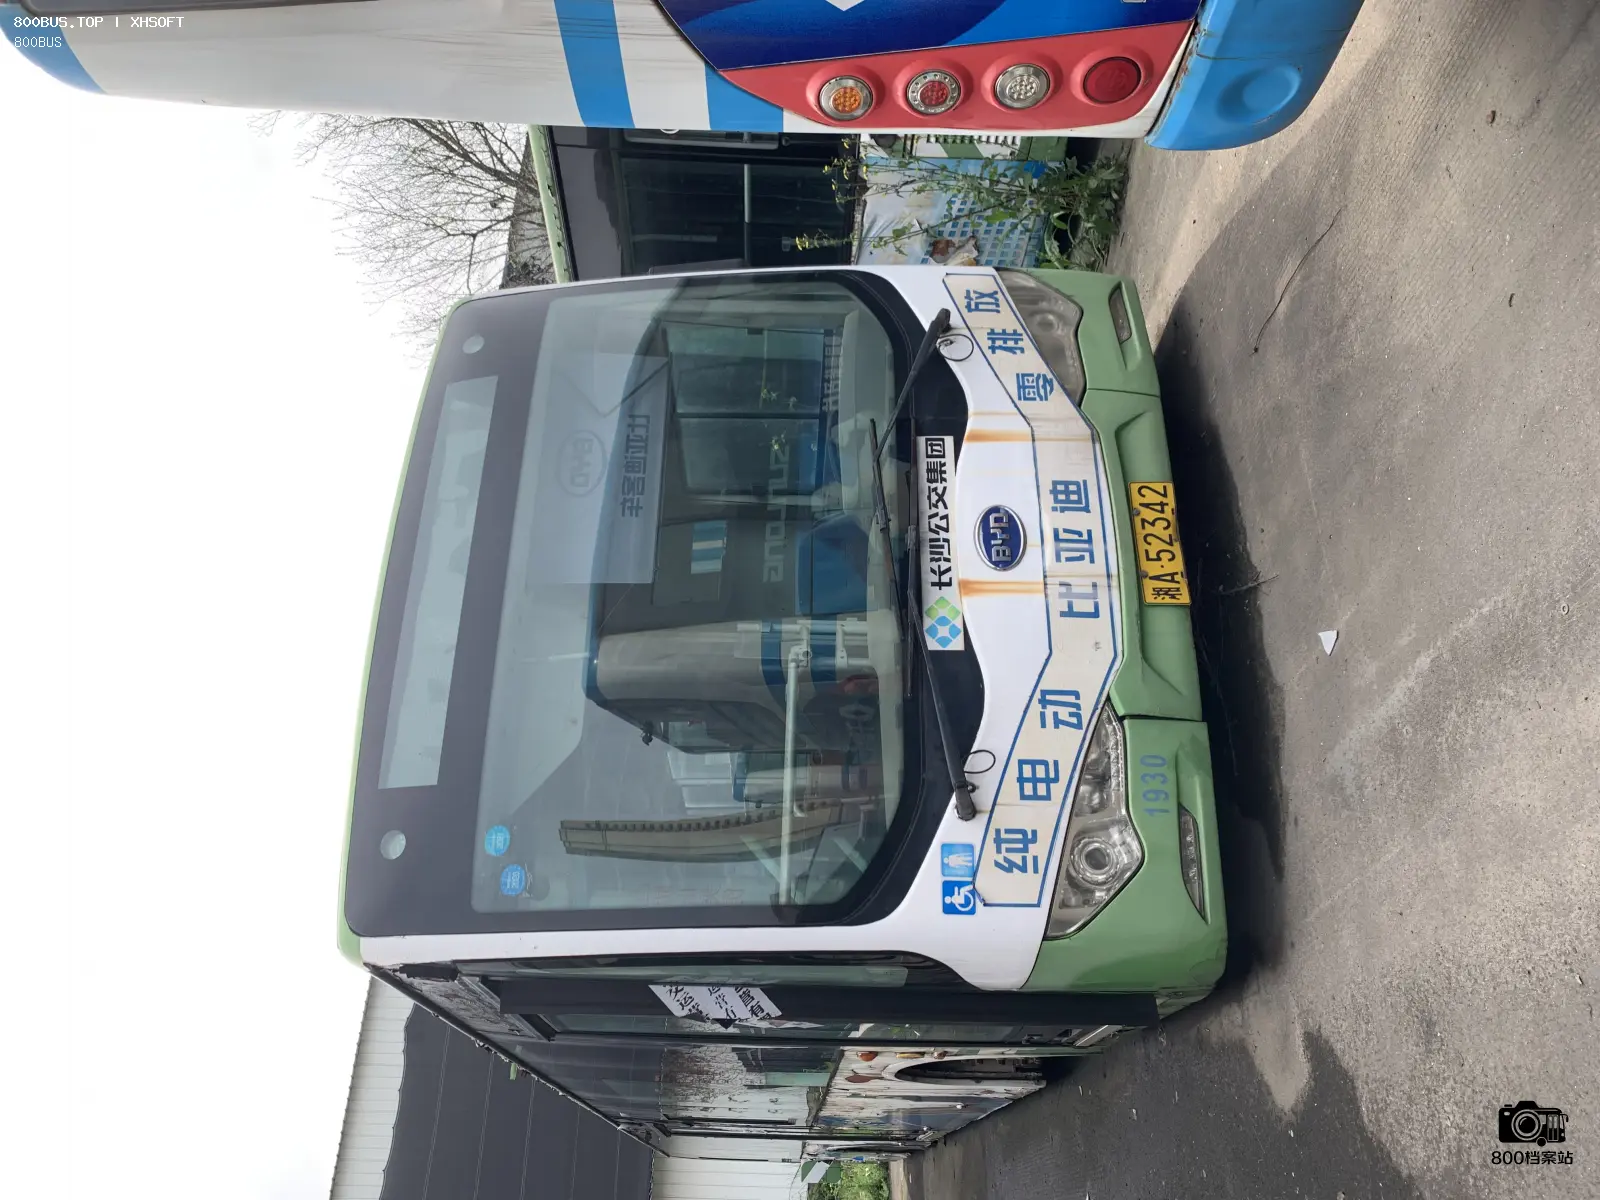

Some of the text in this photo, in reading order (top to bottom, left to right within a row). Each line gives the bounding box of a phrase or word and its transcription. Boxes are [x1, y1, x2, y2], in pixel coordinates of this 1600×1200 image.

[925, 437, 954, 591] 长沙公交集团
[990, 510, 1010, 563] BYD
[965, 289, 1101, 875] 纯电动 比亚迪 零排放
[1140, 754, 1170, 817] 1930
